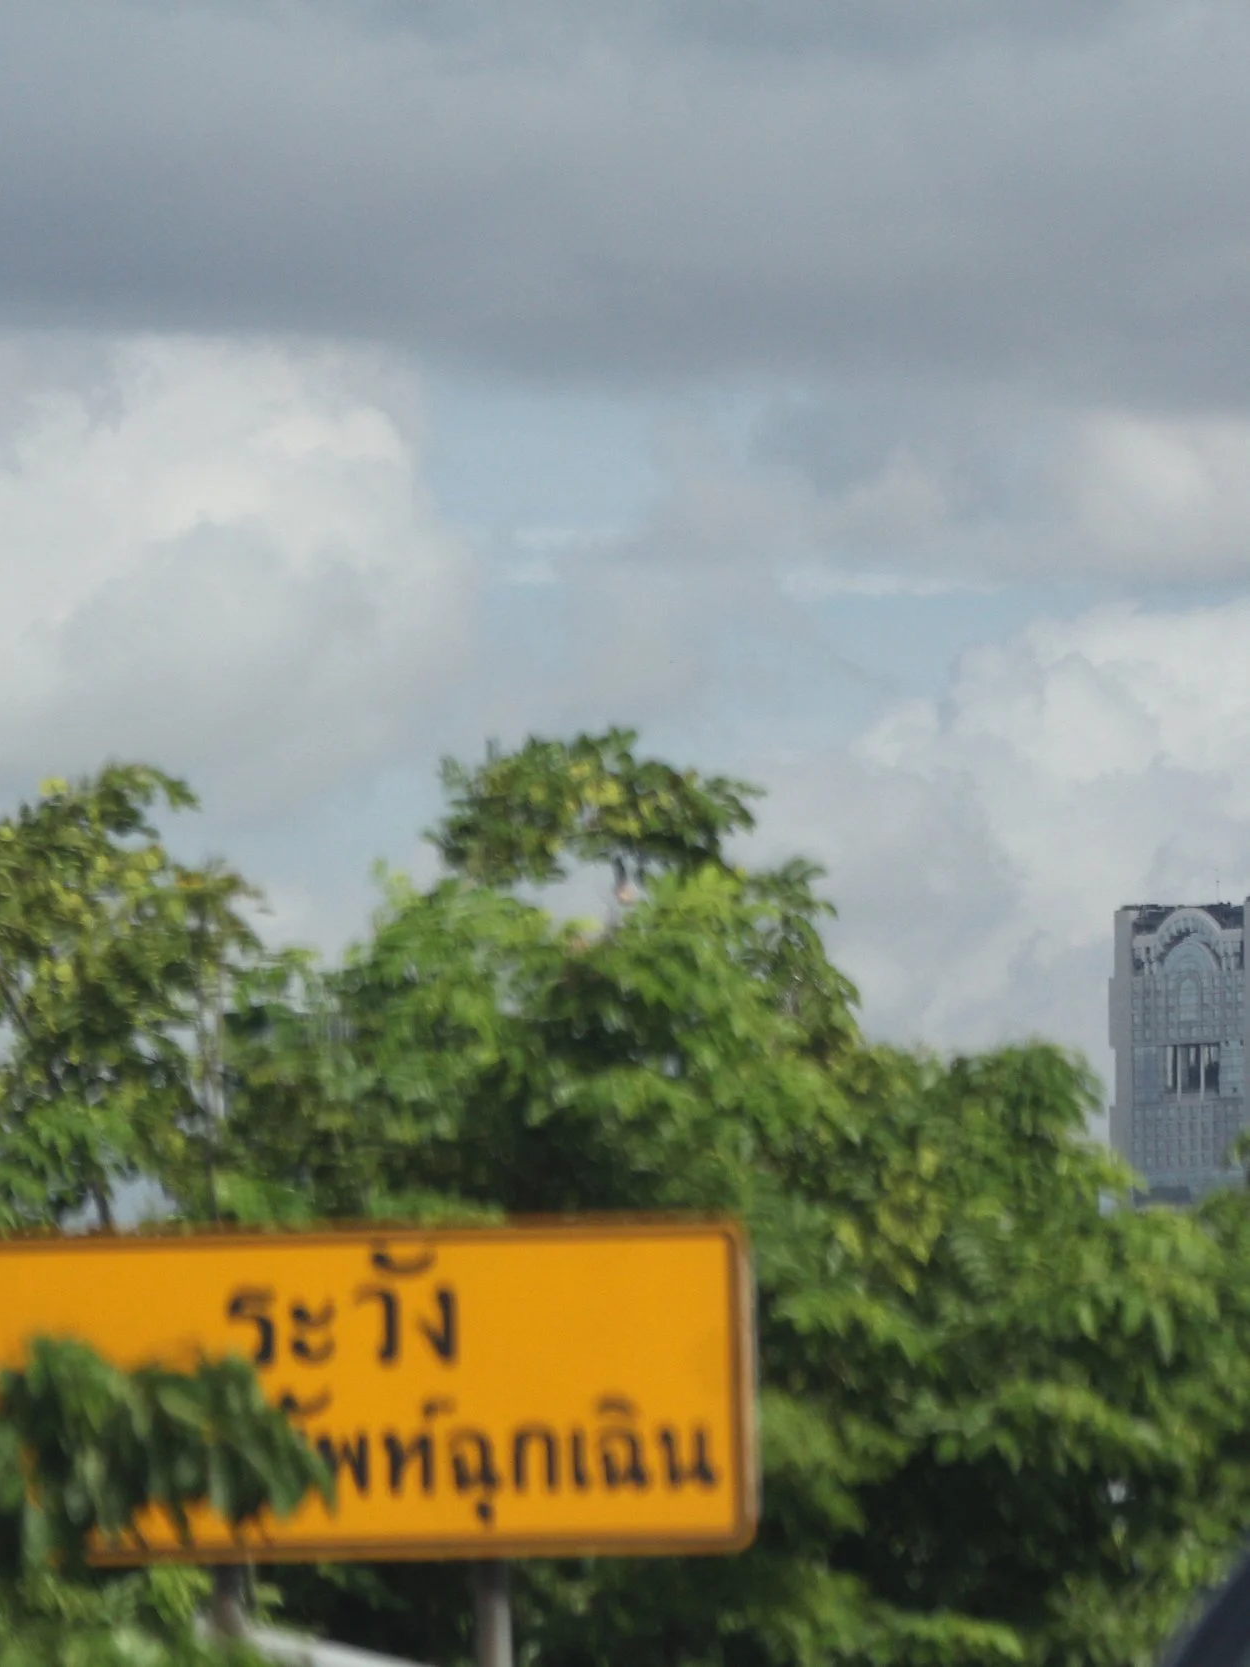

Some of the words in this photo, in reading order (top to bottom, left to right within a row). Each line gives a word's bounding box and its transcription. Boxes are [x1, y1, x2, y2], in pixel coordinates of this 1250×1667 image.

[227, 1241, 458, 1367] ระวัง
[279, 1391, 716, 1525] ัพท์ฉุกเฉิน
